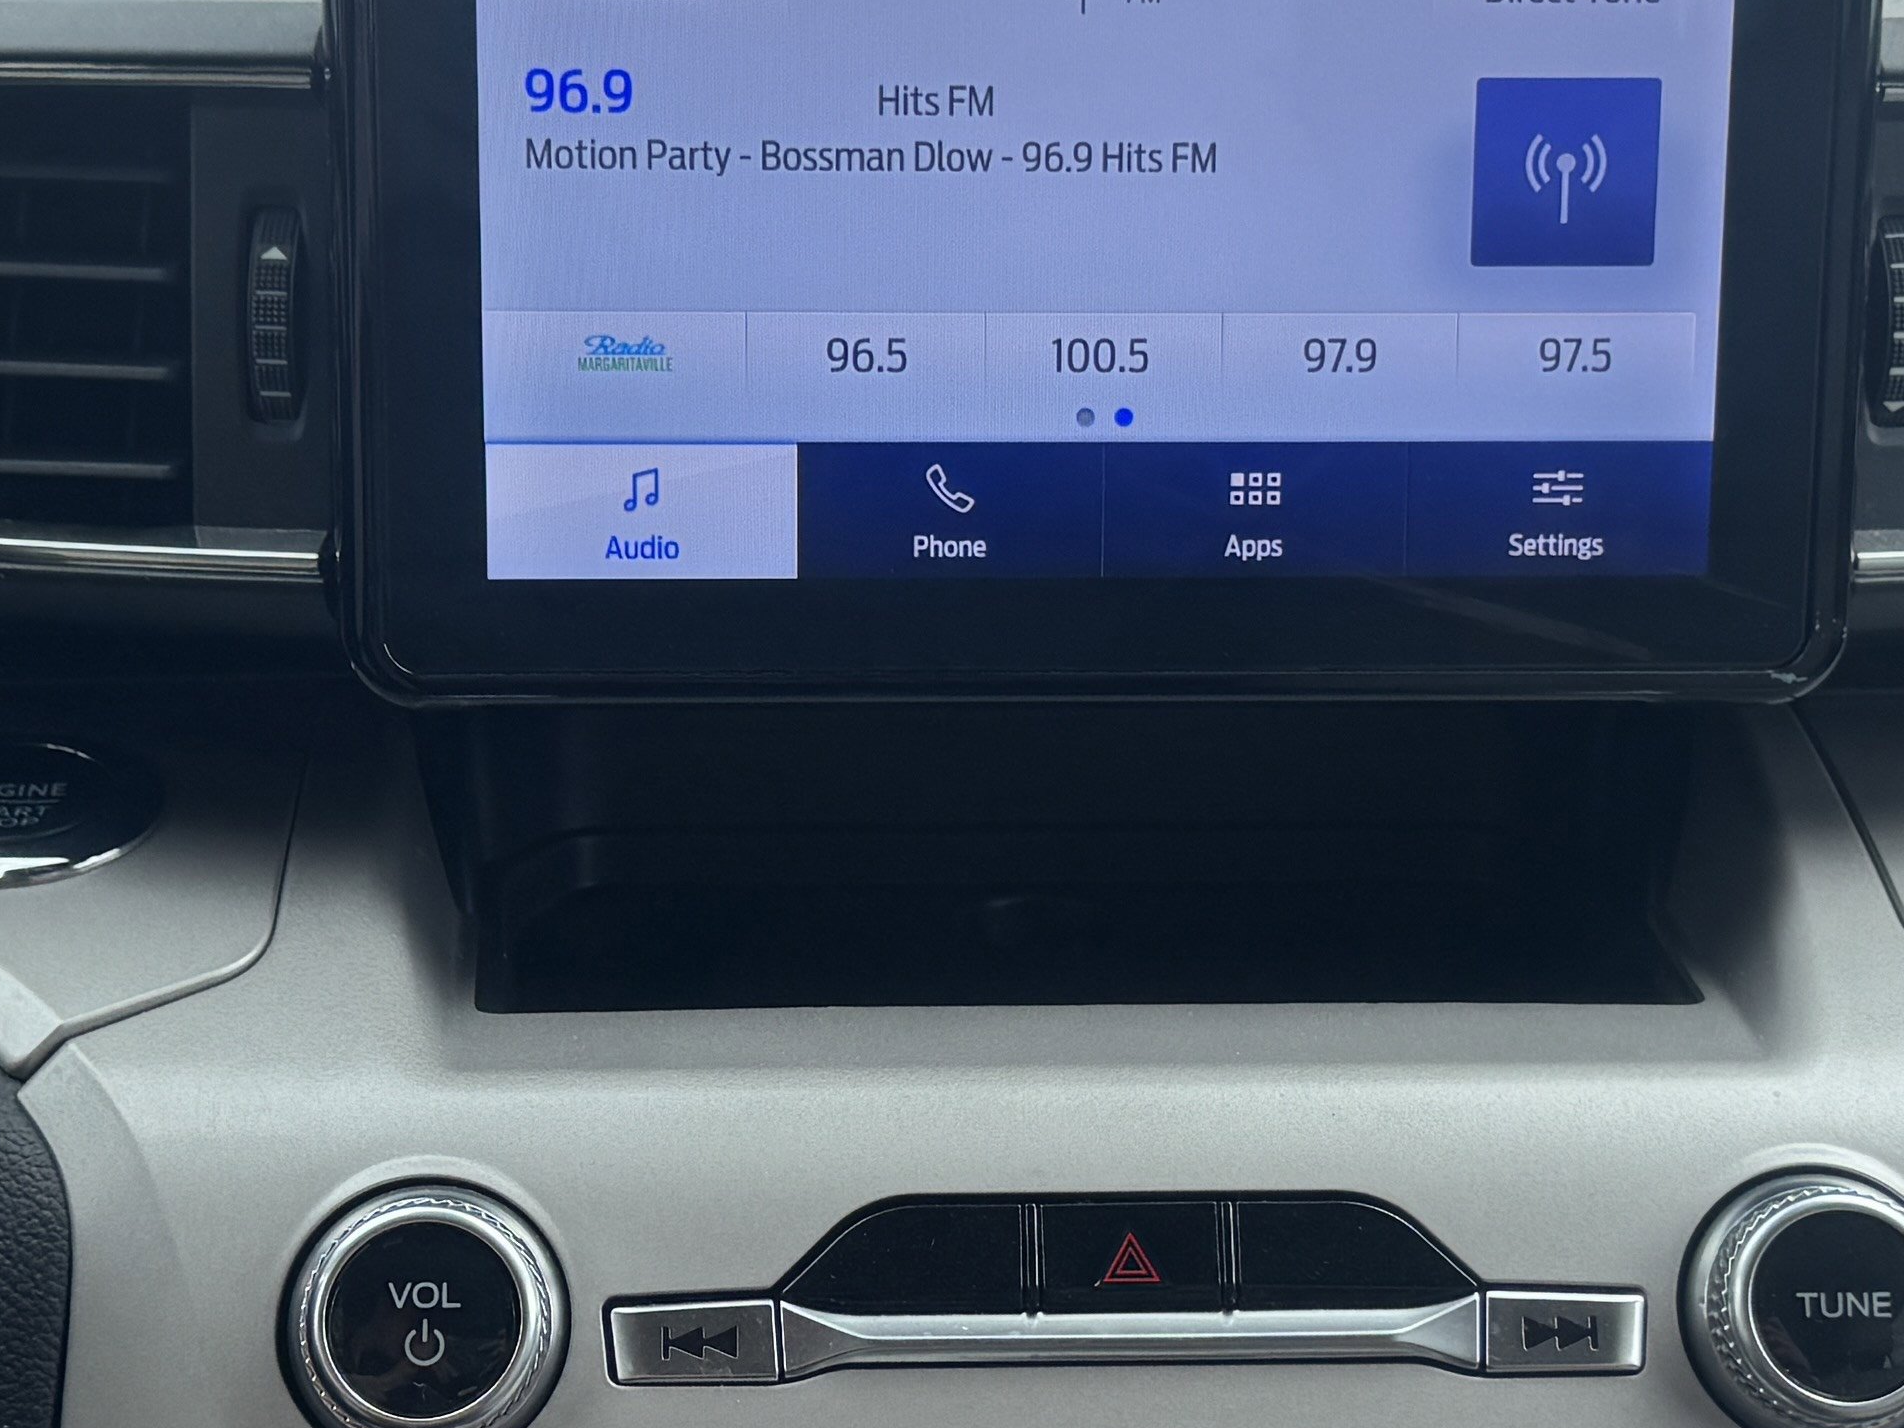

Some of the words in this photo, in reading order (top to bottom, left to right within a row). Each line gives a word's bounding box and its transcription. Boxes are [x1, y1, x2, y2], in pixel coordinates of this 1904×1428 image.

[525, 68, 633, 114] 96.9
[878, 84, 940, 116] Hits
[948, 84, 994, 117] FM
[526, 137, 638, 170] Motion
[647, 138, 732, 177] Party
[761, 139, 905, 172] Bossman
[914, 139, 993, 173] Dlow
[1022, 141, 1093, 173] 96.9
[1102, 141, 1163, 173] Hits
[1172, 141, 1217, 174] FM
[583, 334, 666, 356] Radio
[826, 337, 907, 373] 96.5
[1051, 337, 1149, 374] 100.5
[1303, 337, 1377, 373] 97.9
[1539, 337, 1612, 373] 97.5
[577, 356, 673, 372] MARGARITAVILLE
[605, 534, 680, 560] Audio
[913, 534, 987, 558] Phone
[1224, 534, 1283, 562] Apps
[1508, 532, 1604, 561] Settings
[388, 1281, 462, 1309] VOL
[1795, 1291, 1893, 1318] TUNE
